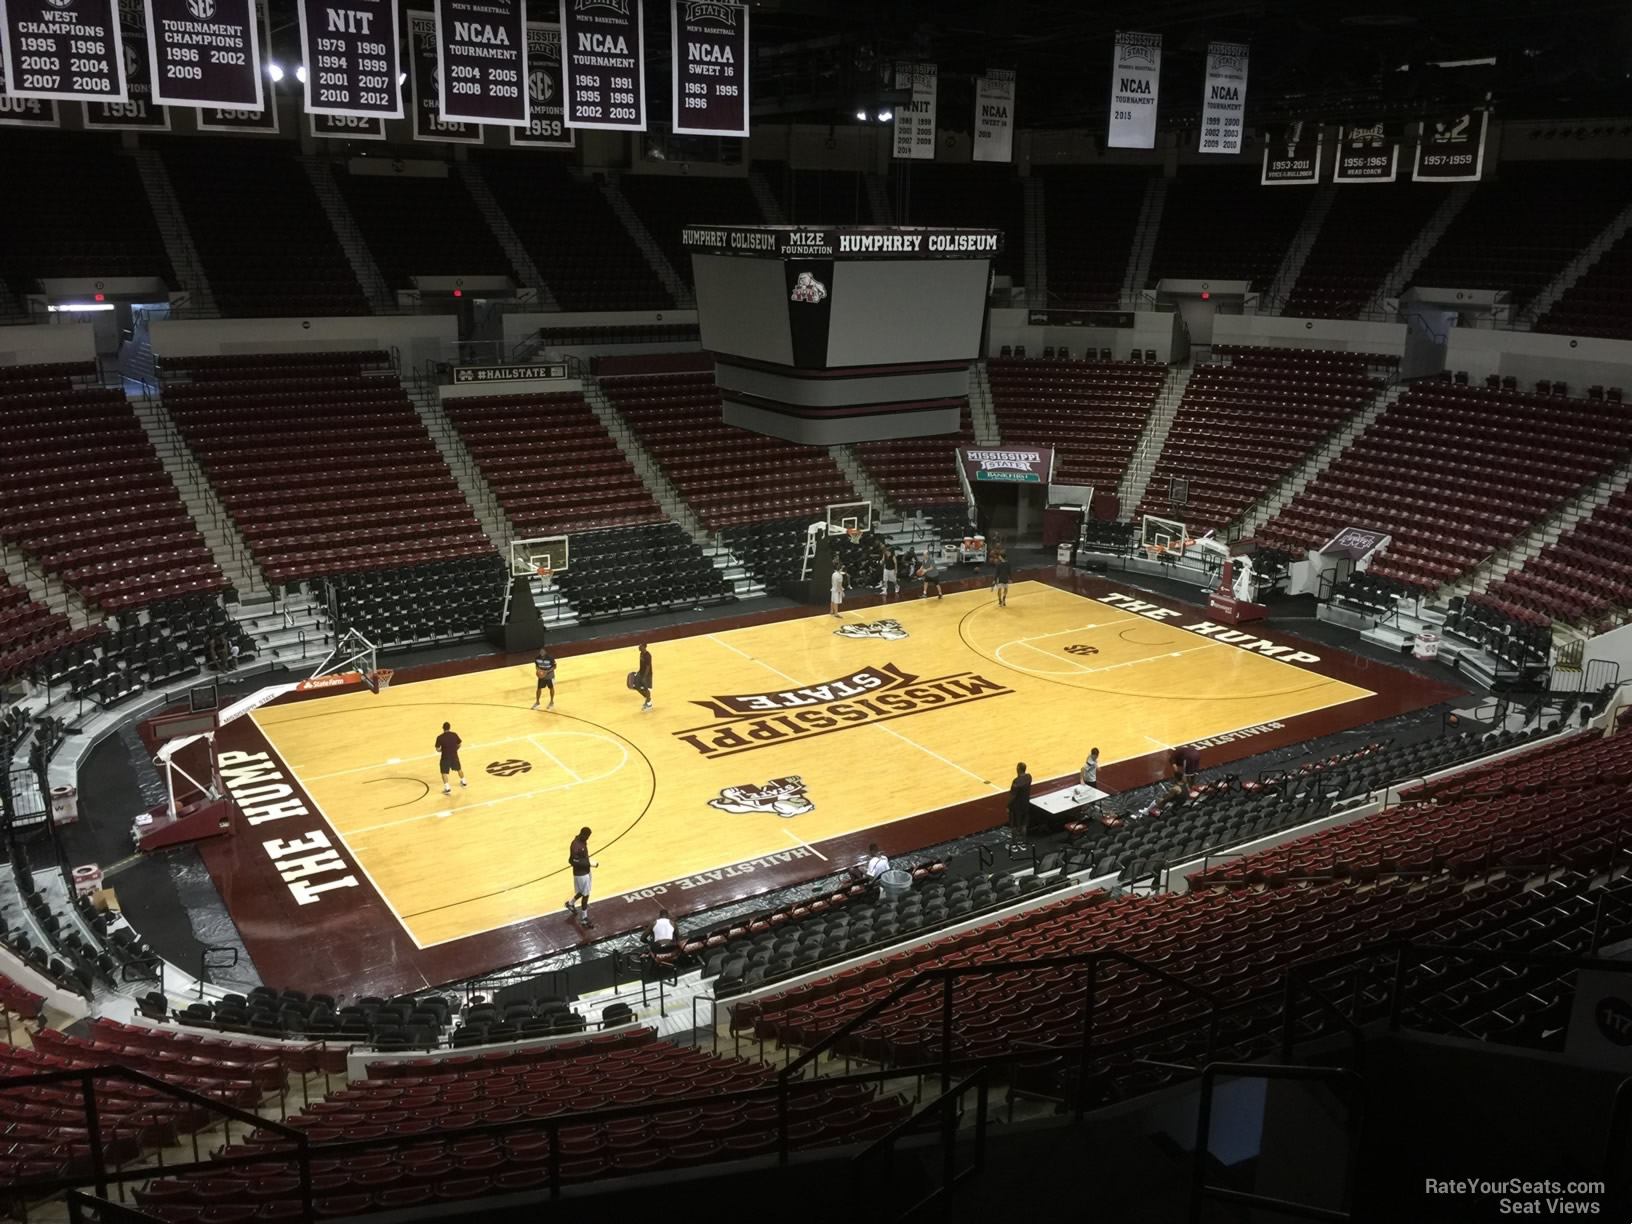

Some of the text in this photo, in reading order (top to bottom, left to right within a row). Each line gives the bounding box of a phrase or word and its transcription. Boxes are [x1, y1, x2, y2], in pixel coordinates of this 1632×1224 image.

[42, 10, 78, 23] WEST
[473, 5, 510, 15] BASKETBALL
[695, 5, 726, 18] STATE
[162, 20, 243, 36] TOURNAMENT
[326, 8, 373, 35] NIT
[594, 16, 629, 25] BASKETBALL
[18, 22, 104, 37] CHAMPIONS
[454, 21, 510, 46] NCAA
[704, 27, 735, 36] BASKETBALL
[20, 37, 105, 55] 1995 1996
[164, 32, 244, 48] CHAMPIONS
[317, 38, 386, 56] 1979 1990
[578, 32, 629, 54] NCAA
[166, 47, 245, 65] 1996 2002
[449, 44, 518, 60] TOURNAMENT
[688, 42, 734, 63] NCAA
[1127, 47, 1149, 58] STATE
[21, 56, 60, 70] 2003
[70, 58, 109, 73] 2004
[318, 55, 388, 72] 1994 1999
[573, 55, 635, 68] TOURNAMENT
[167, 64, 202, 80] 2009
[451, 65, 518, 82] 2004 2005
[688, 63, 734, 77] SWEET 16
[23, 74, 61, 89] 2007
[72, 76, 111, 91] 2008
[319, 72, 389, 89] 2001 2007
[575, 75, 633, 89] 1963 1991
[1120, 78, 1151, 94] NCAA
[320, 89, 389, 105] 2010 2012
[452, 82, 518, 98] 2008 2009
[576, 90, 634, 104] 1995 1996
[685, 82, 738, 97] 1963 1995
[1211, 85, 1239, 100] NCAA
[685, 97, 707, 109] 1996
[1115, 96, 1155, 105] TOURNAMENT
[1208, 102, 1242, 110] TOURNAMENT
[530, 105, 564, 115] AMPIONS
[576, 105, 636, 120] 2002 2003
[982, 105, 1008, 118] NCAA
[1115, 111, 1132, 120] 2015
[525, 119, 561, 136] 1959
[1223, 141, 1237, 149] 2010
[1272, 161, 1309, 170] 1953-2011
[1344, 156, 1387, 167] 1956-1965
[1423, 155, 1473, 166] 1957-1959
[682, 229, 776, 250] HUMPHREY COLISEUM
[790, 232, 824, 245] MIZE
[840, 235, 997, 252] HUMPHREY COLISEUM
[781, 245, 833, 254] FOUNDATION
[477, 368, 546, 380] #HAILSTATE
[967, 452, 1040, 461] MISSISSIPPI
[990, 460, 1020, 468] STATE
[1097, 592, 1182, 620] THE
[1181, 621, 1320, 663] HUMP
[329, 678, 344, 687] Farm
[736, 672, 882, 710] STATE
[677, 674, 1007, 755] MISSISSIPPI
[1189, 721, 1286, 751] #HAILSTAT
[217, 750, 360, 906] THE HUMP
[622, 846, 813, 904] HAILSTATE.COM
